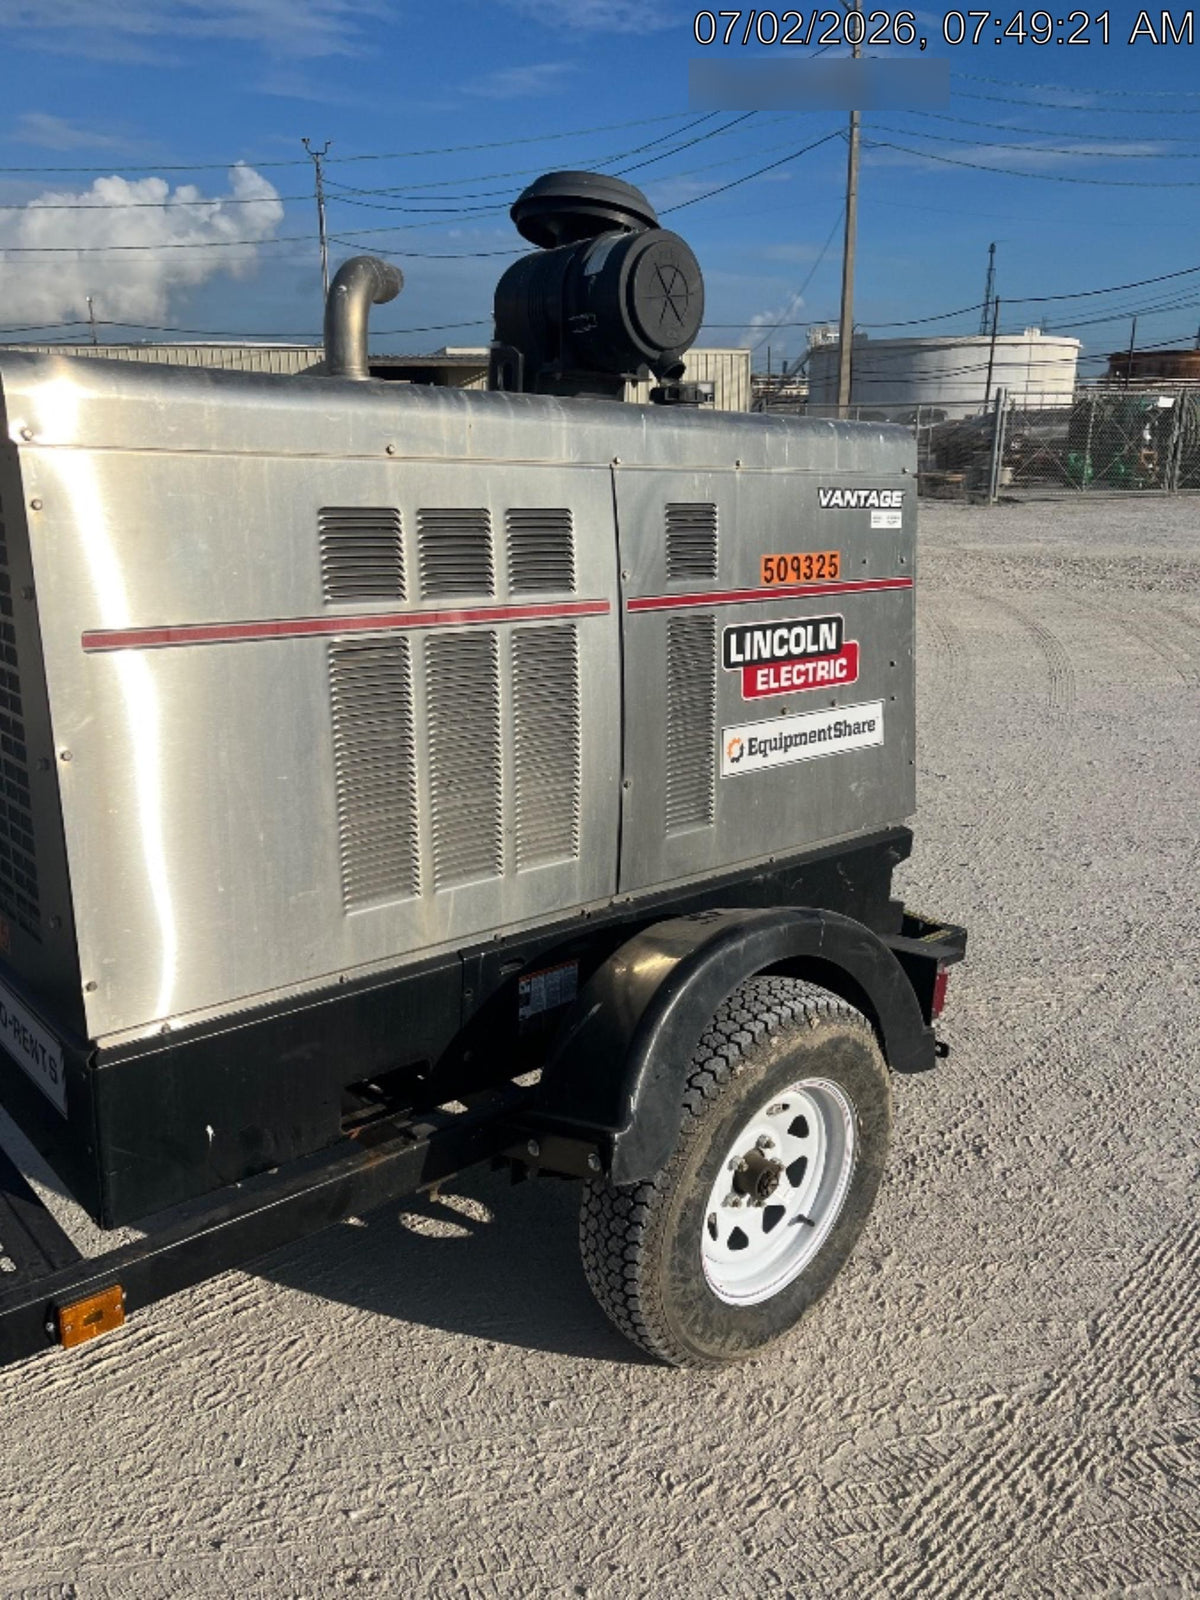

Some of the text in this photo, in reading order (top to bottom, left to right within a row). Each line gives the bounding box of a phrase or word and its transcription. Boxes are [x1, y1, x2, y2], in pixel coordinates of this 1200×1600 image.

[818, 488, 904, 508] VANTAGE
[763, 553, 839, 583] 509325
[730, 621, 837, 663] LINCOLN
[756, 658, 847, 691] ELECTRIC
[747, 718, 876, 756] EquipmentShare
